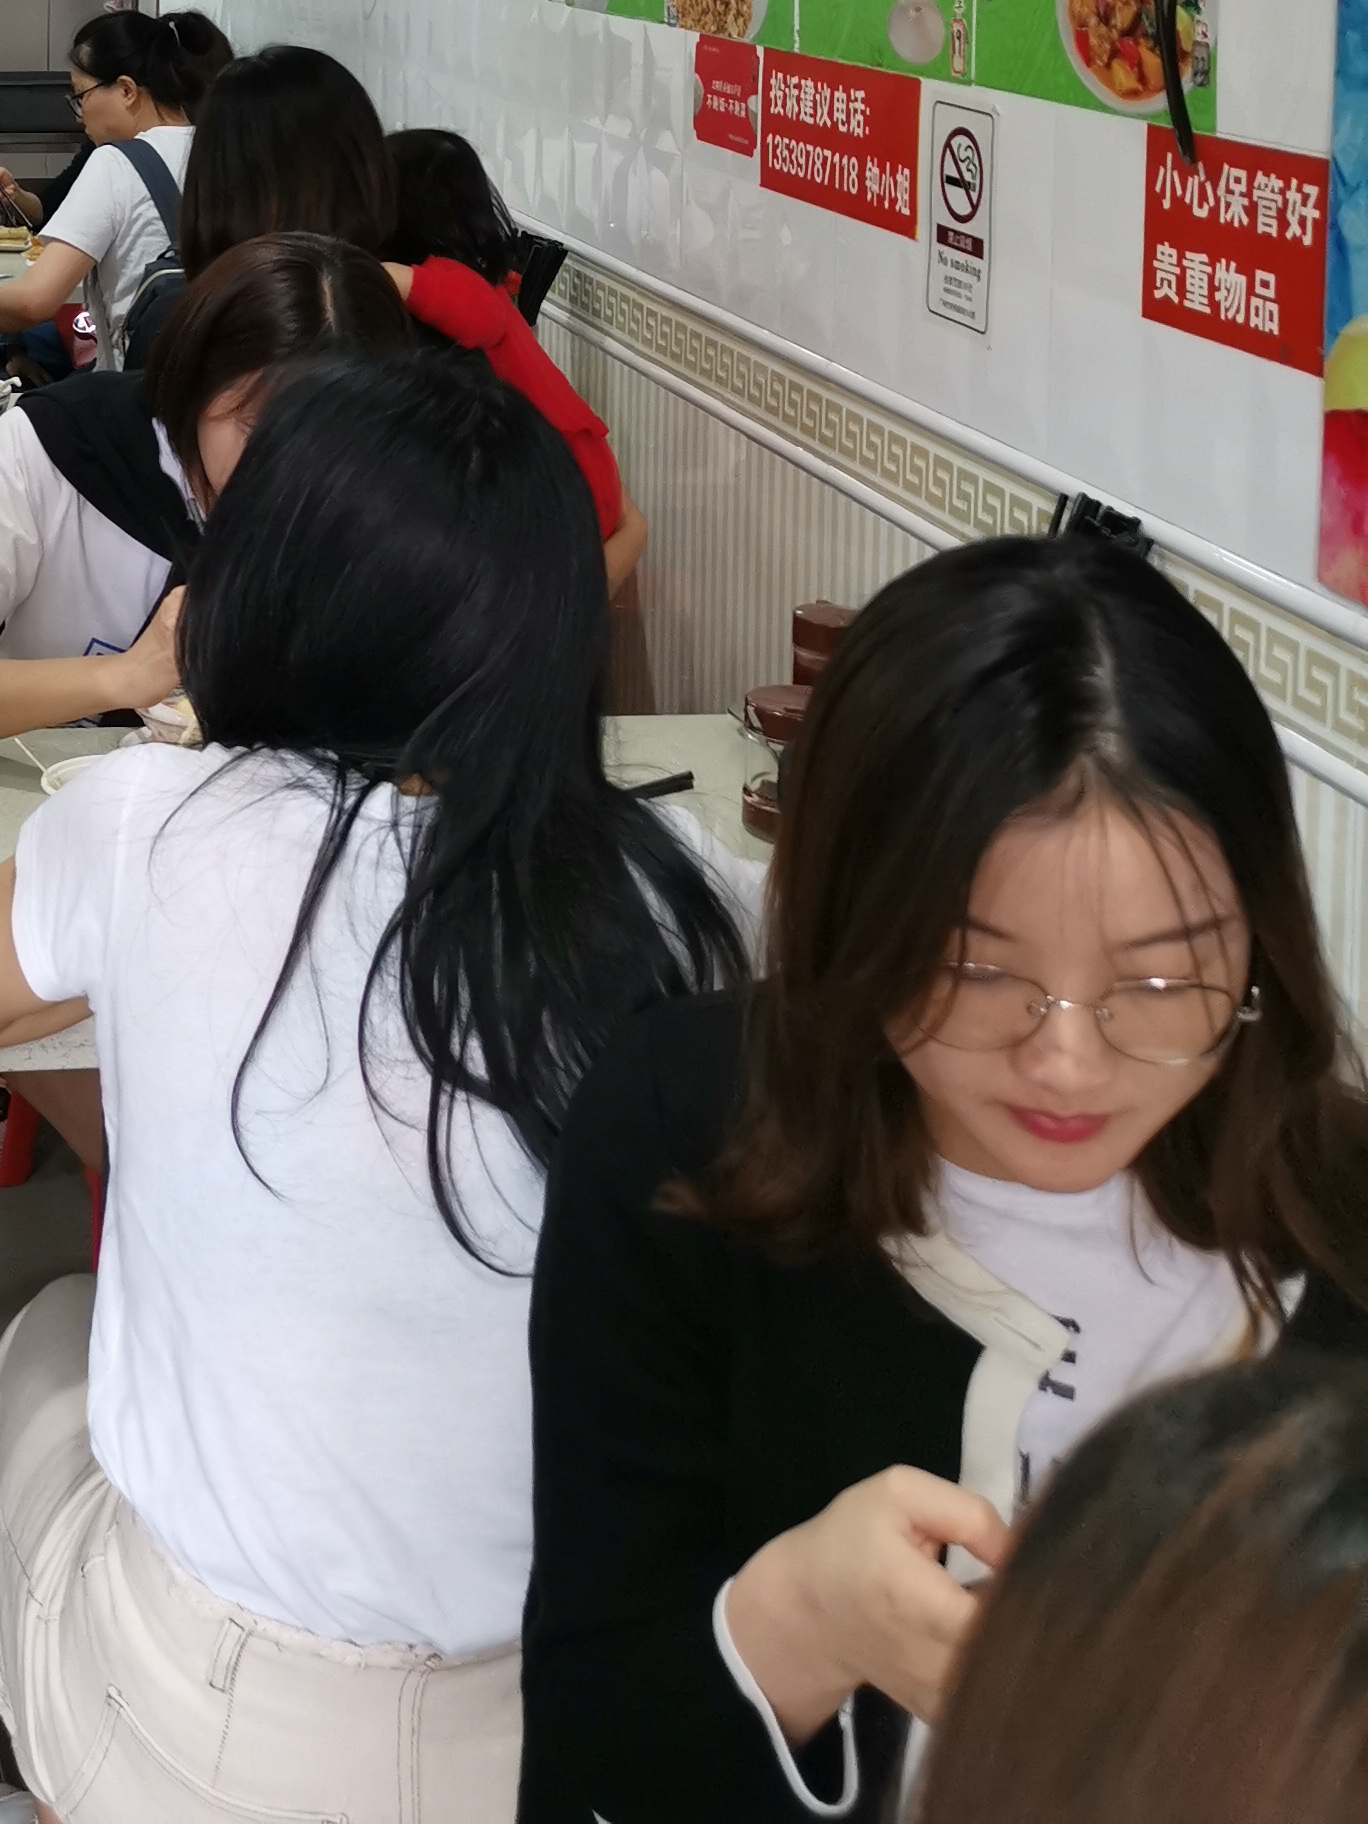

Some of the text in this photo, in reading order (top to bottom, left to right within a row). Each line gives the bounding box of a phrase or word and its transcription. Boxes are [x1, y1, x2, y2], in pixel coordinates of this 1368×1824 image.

[769, 69, 870, 137] 投诉建议电话:
[766, 132, 911, 216] 13539787118 钟小姐
[1155, 151, 1320, 247] 小心保管好
[1152, 241, 1280, 336] 贵重物品
